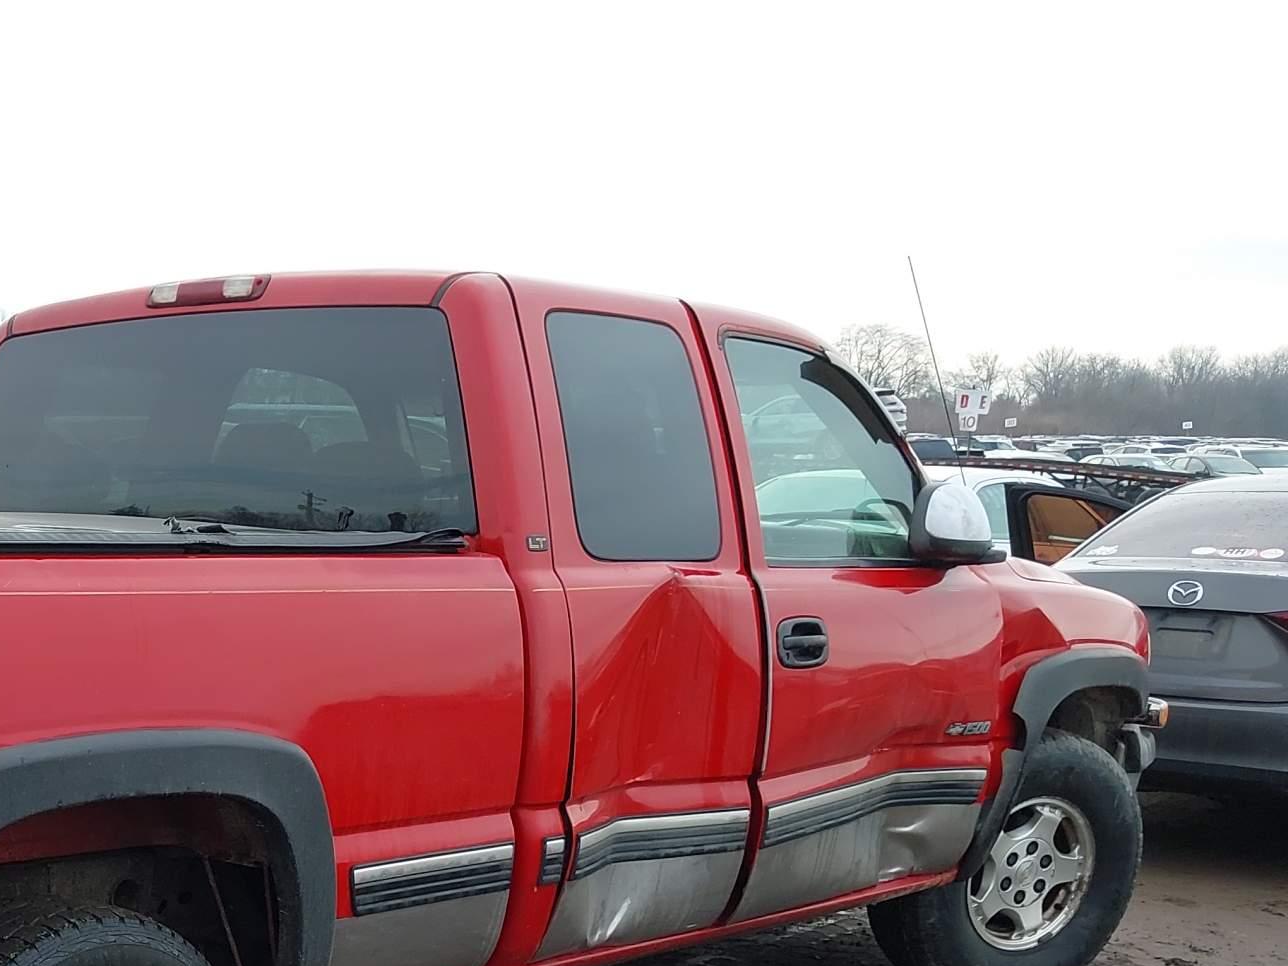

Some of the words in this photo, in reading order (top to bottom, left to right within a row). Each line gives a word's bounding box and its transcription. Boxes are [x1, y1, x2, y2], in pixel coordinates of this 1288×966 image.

[960, 395, 969, 408] D
[979, 395, 988, 409] E
[961, 415, 976, 428] 10
[528, 537, 547, 549] LT
